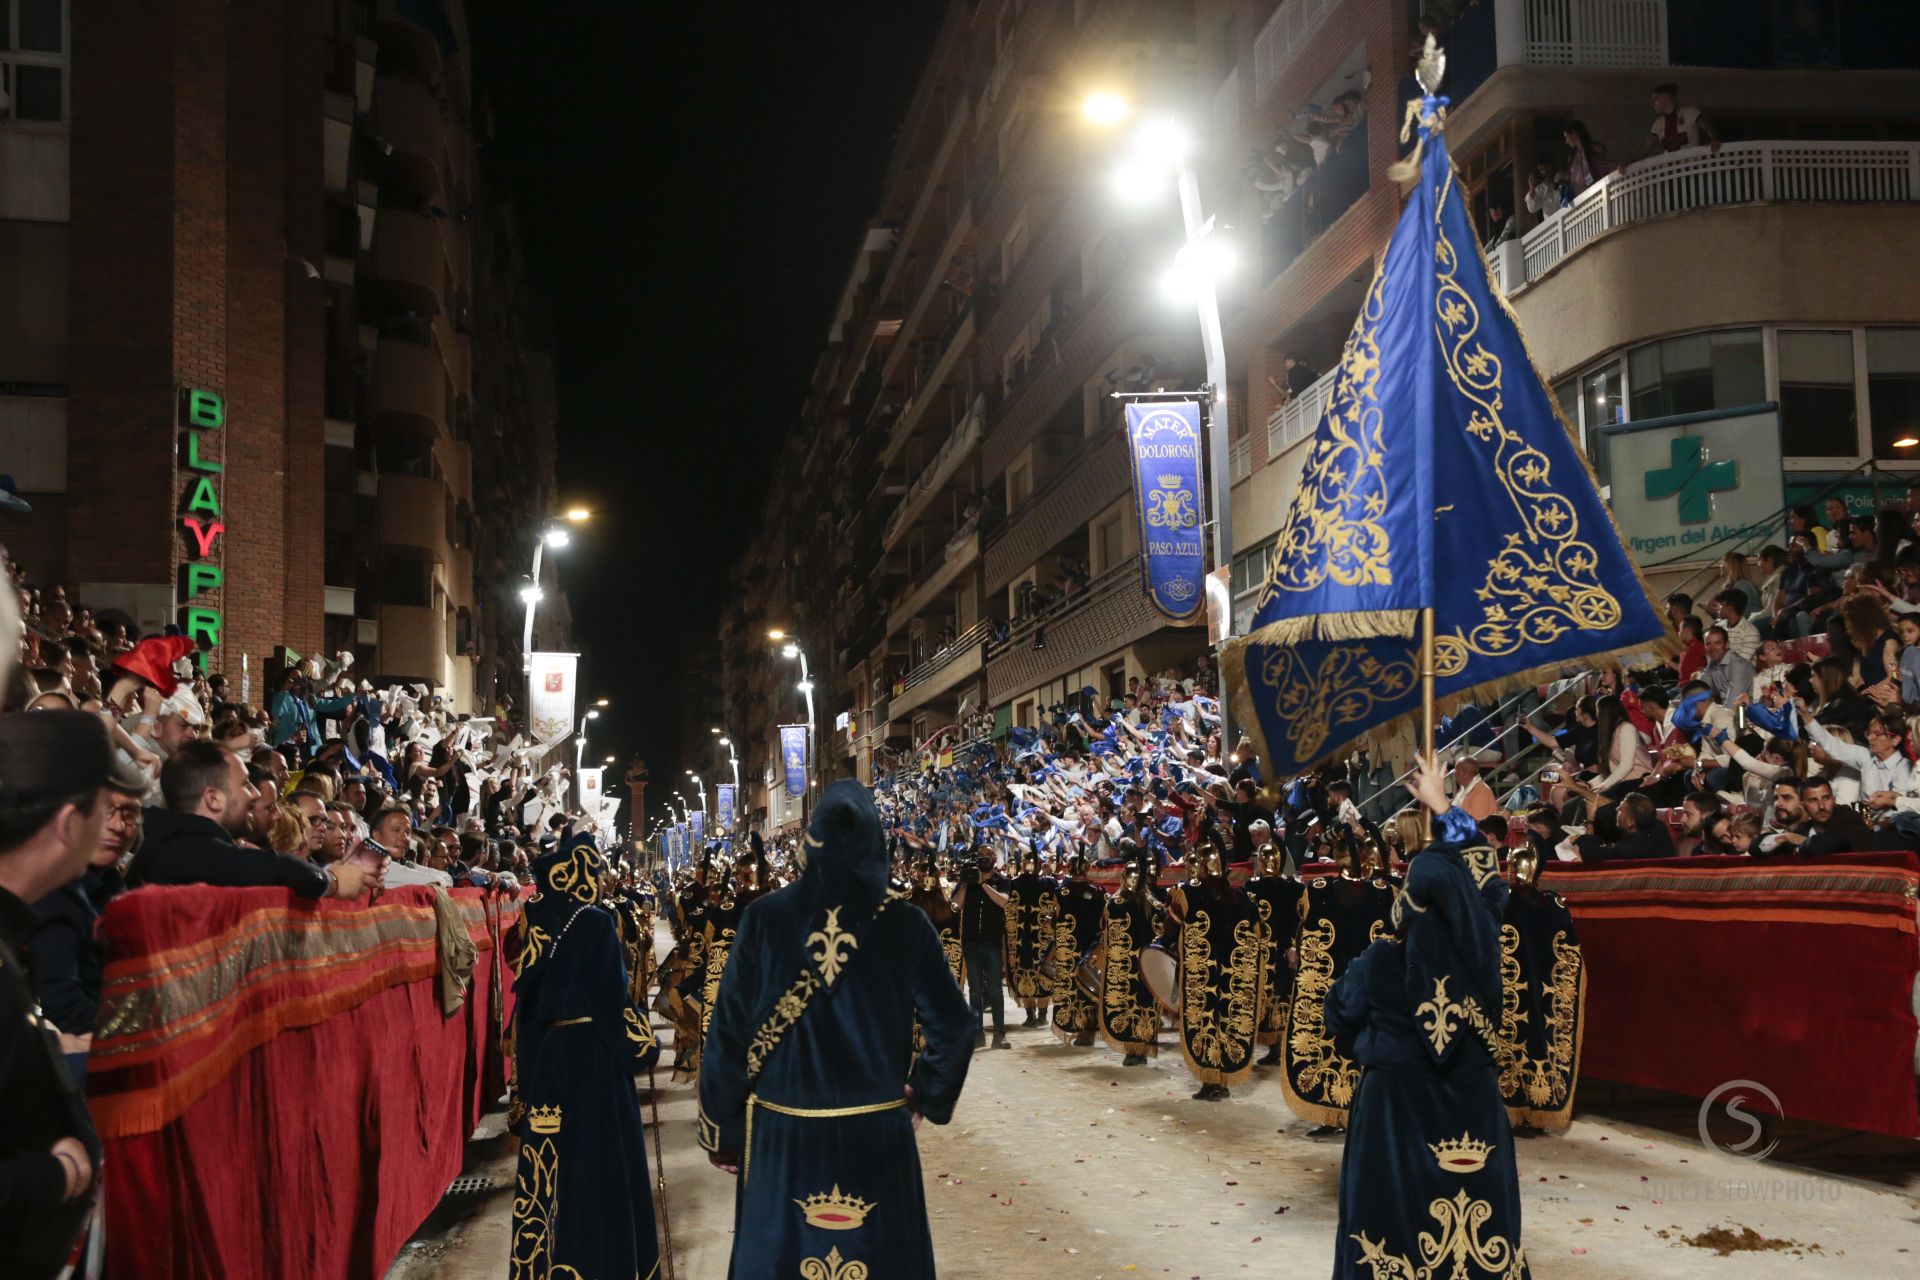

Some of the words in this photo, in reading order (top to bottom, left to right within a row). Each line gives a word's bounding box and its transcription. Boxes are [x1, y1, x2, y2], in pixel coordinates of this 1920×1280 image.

[1143, 417, 1189, 440] MATER
[1138, 444, 1195, 459] DOLOROSA
[1680, 528, 1705, 544] del
[1149, 541, 1173, 556] PASO
[1175, 541, 1201, 556] AZUL
